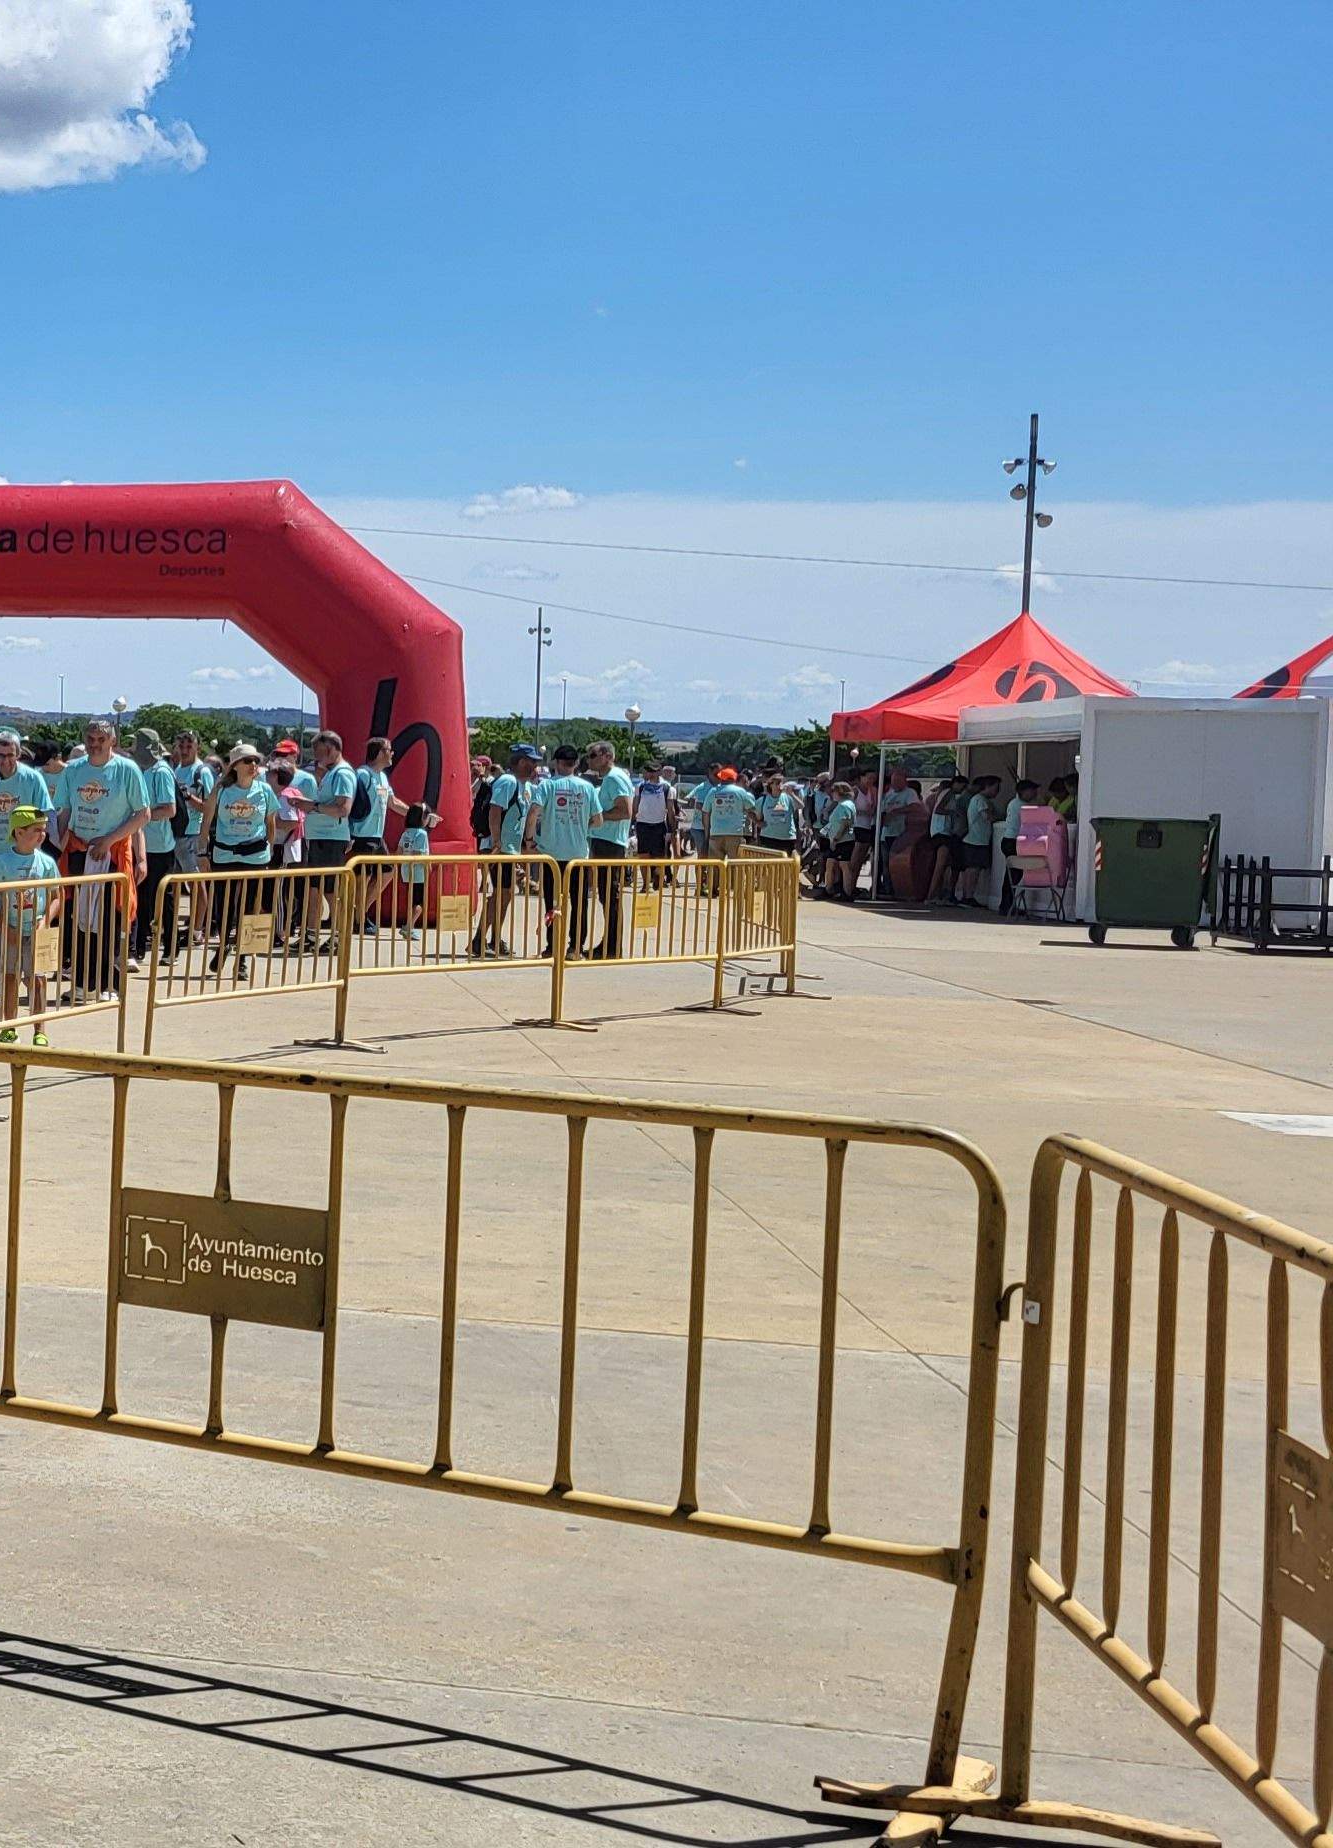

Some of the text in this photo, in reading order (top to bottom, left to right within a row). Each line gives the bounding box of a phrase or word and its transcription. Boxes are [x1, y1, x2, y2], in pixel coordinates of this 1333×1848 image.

[27, 520, 74, 554] de
[84, 520, 228, 555] huesca
[158, 563, 226, 578] Deportes
[188, 1232, 324, 1267] Ayuntamiento
[187, 1254, 298, 1287] de Huesca
